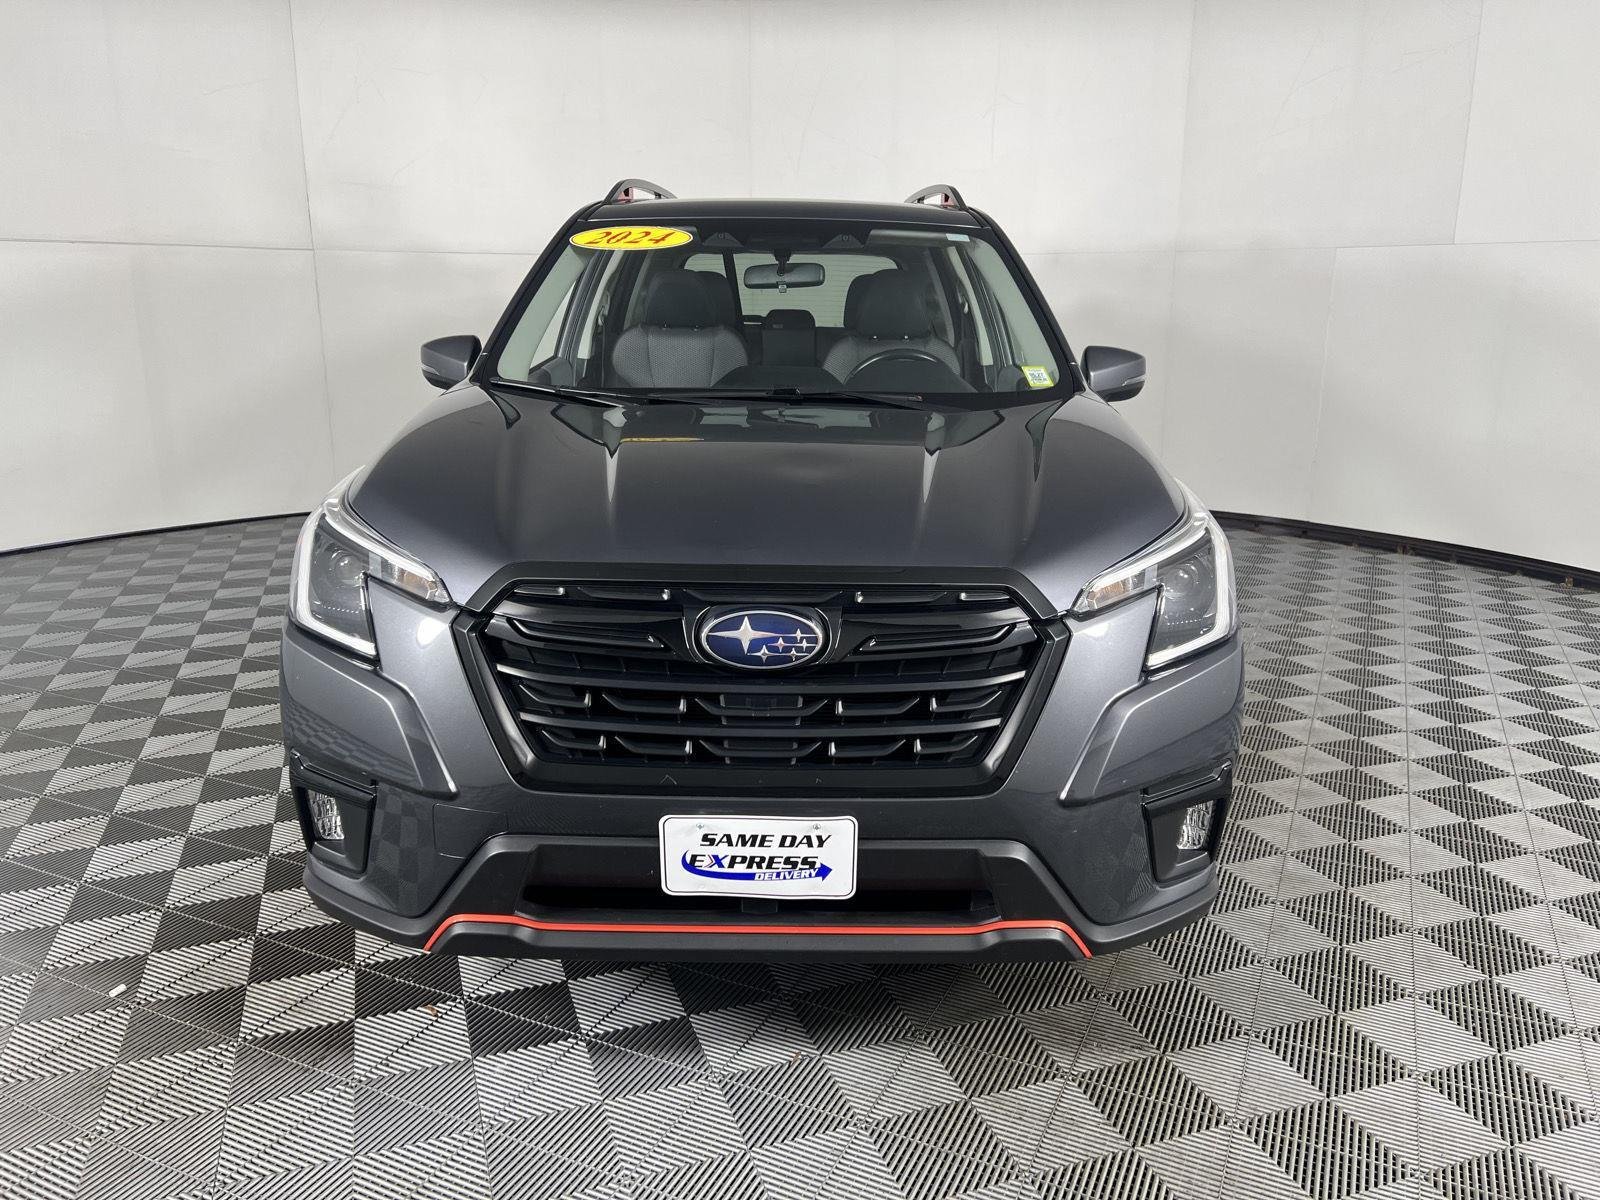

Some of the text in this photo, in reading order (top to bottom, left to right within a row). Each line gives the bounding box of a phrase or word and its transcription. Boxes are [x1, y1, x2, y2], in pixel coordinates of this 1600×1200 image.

[584, 231, 676, 245] 2024
[700, 833, 832, 848] SAME DAY
[689, 854, 818, 870] EXPRESS
[754, 868, 818, 881] DELIVERY
